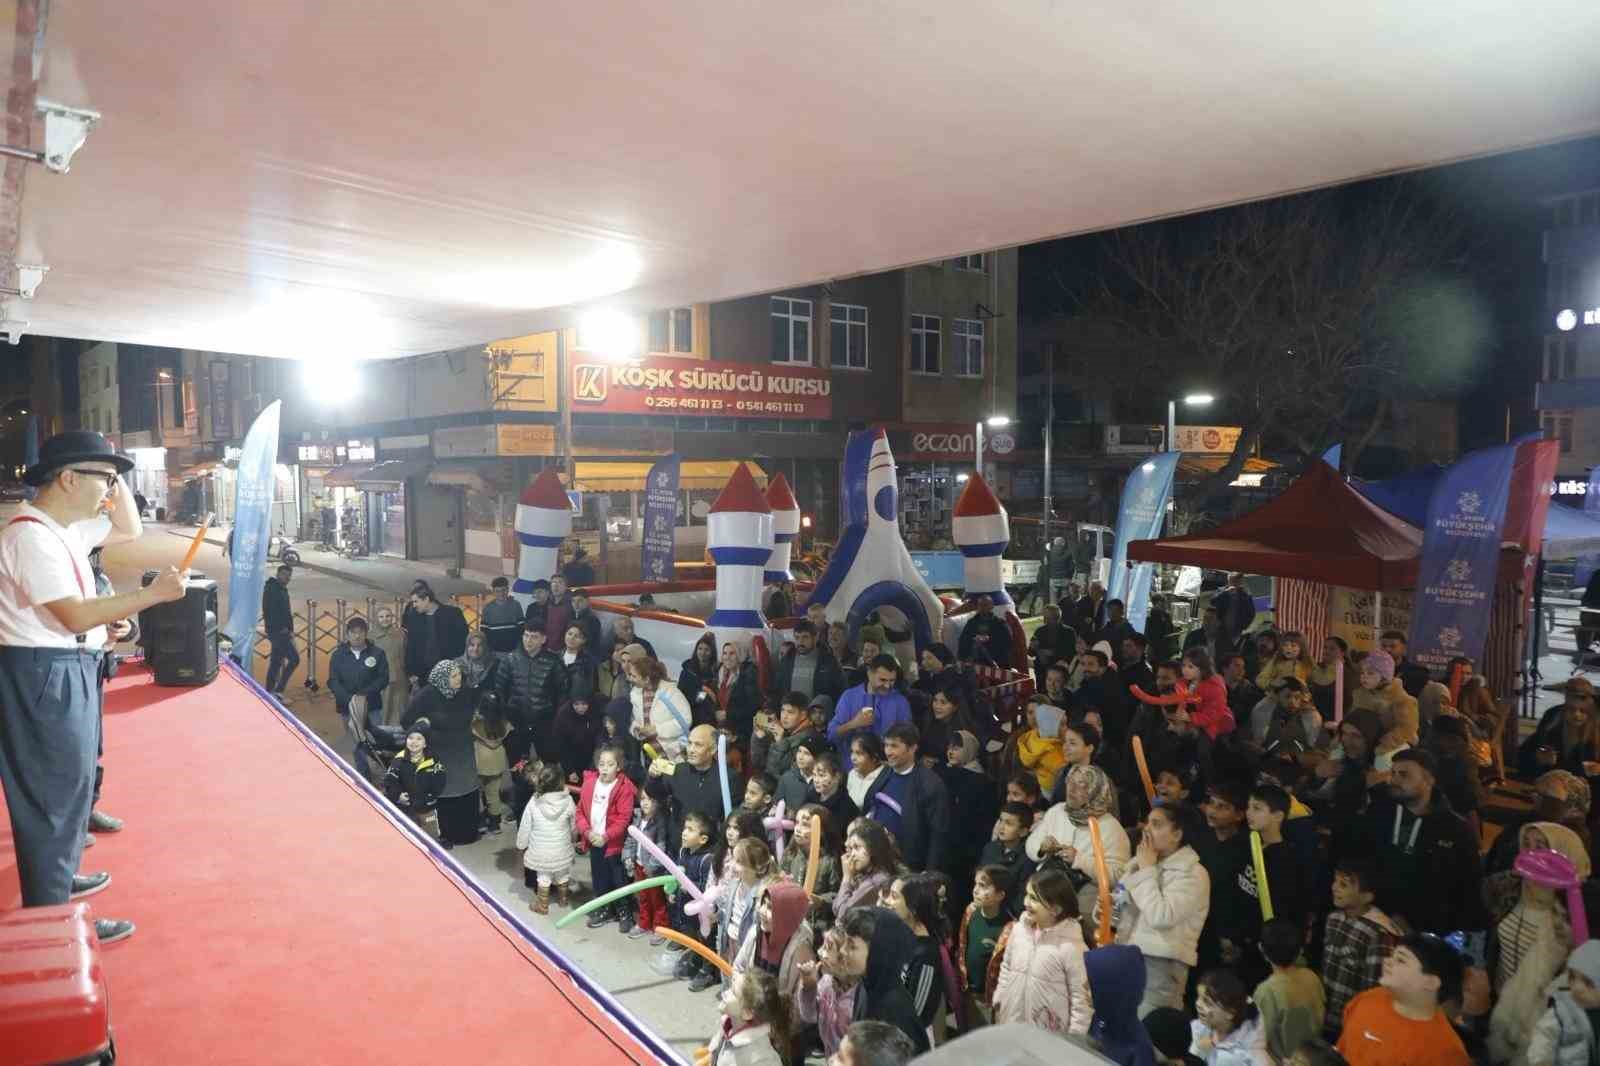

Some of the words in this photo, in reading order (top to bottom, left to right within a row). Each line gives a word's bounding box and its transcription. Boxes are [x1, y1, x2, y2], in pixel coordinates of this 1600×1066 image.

[612, 362, 674, 390] KÖŞK
[679, 367, 763, 392] SÜRÜCÜ
[768, 375, 831, 396] KURSU
